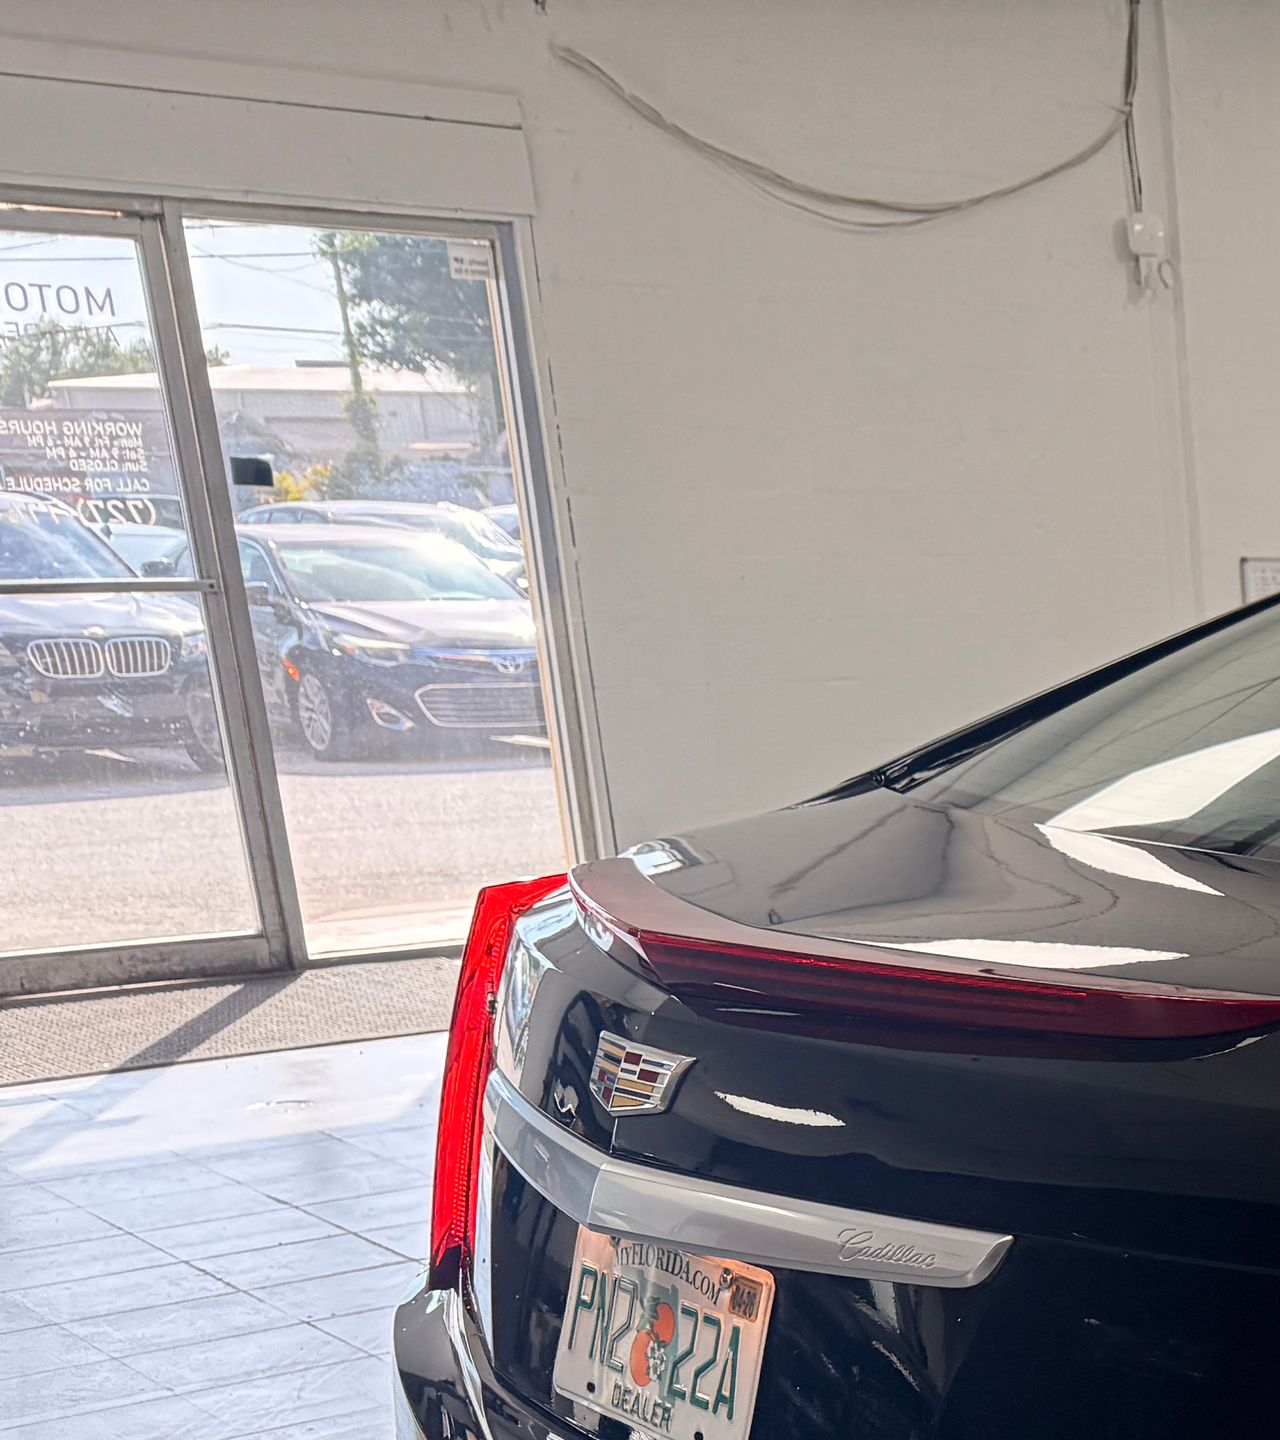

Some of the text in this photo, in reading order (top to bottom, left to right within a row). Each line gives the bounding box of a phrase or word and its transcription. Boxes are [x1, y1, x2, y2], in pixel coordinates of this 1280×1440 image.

[614, 1242, 722, 1306] MYFLORIDA.COM
[837, 1228, 937, 1269] Cadillac
[610, 1381, 675, 1434] DEALER
